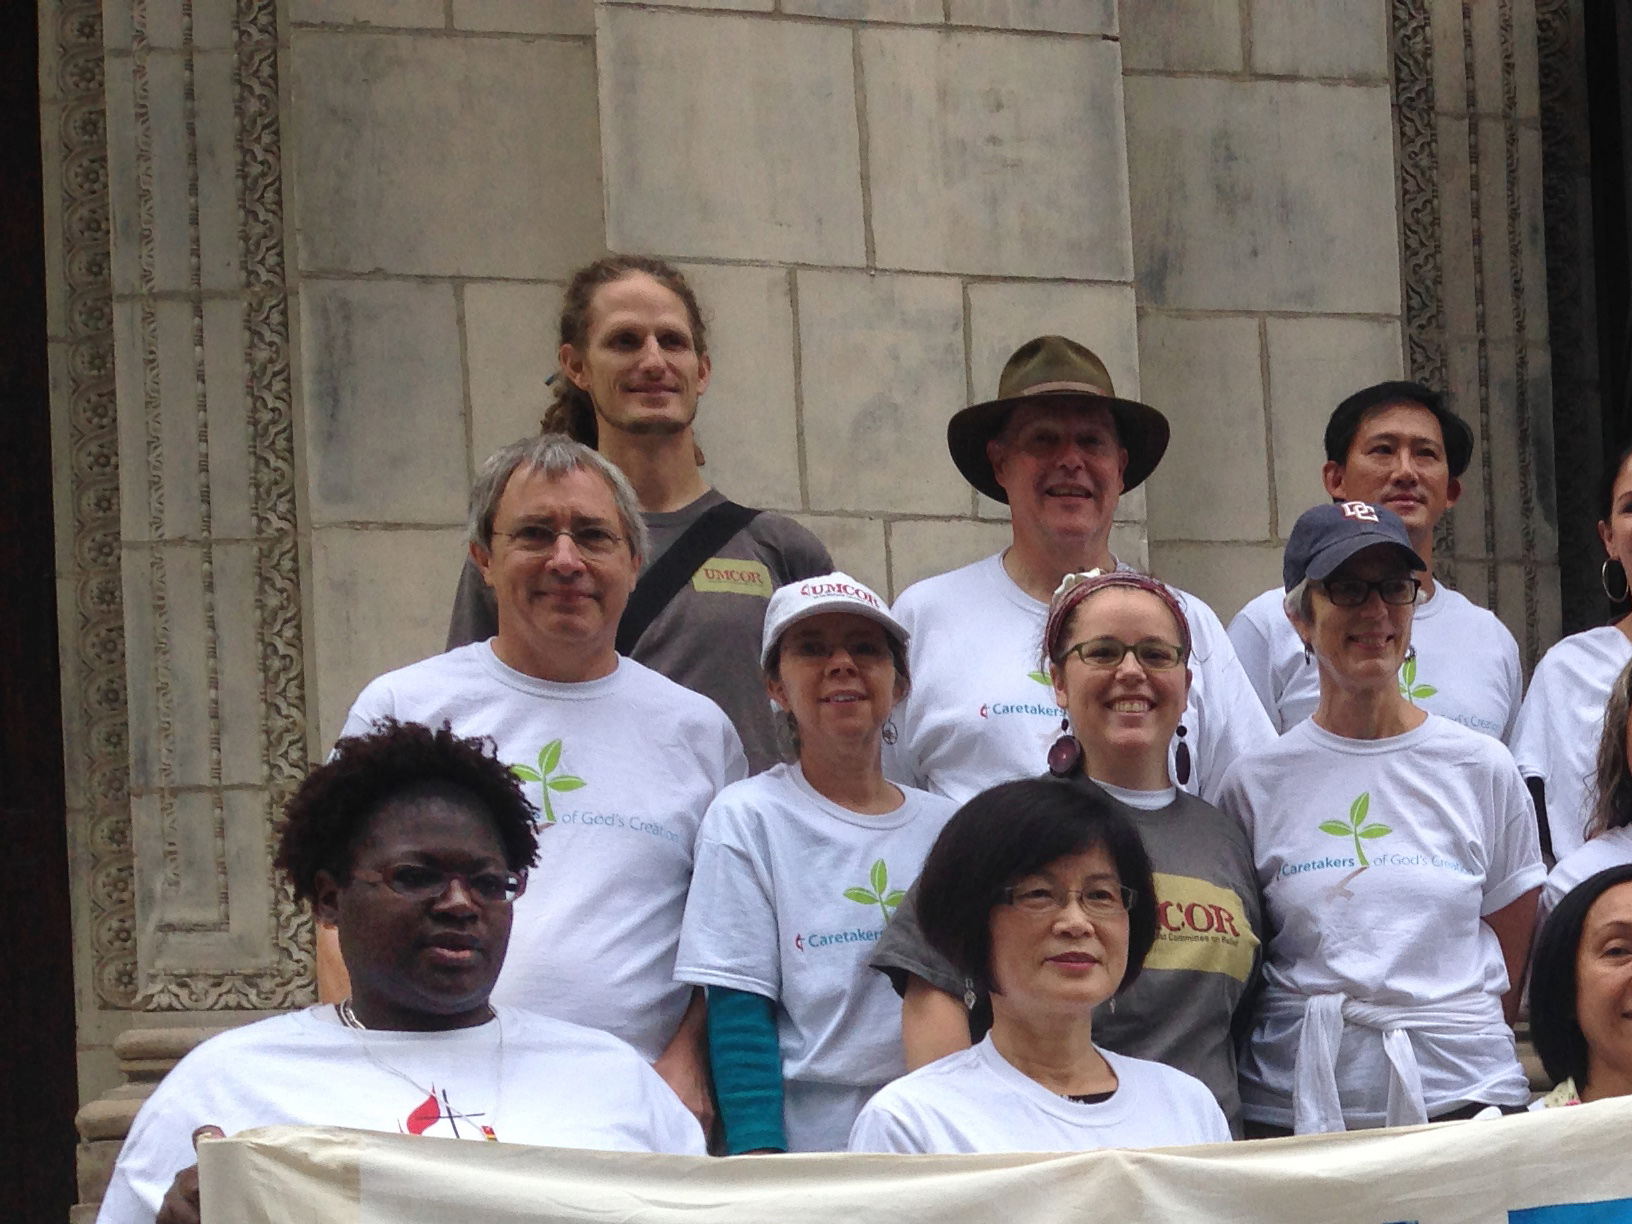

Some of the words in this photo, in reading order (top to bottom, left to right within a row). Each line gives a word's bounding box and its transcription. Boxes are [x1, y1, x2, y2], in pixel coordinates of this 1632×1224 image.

[704, 568, 763, 584] UMCOR
[811, 583, 880, 608] UMCOR
[562, 811, 578, 824] of
[582, 811, 625, 828] God's
[1281, 857, 1355, 877] Caretakers
[1374, 854, 1387, 866] of
[1391, 854, 1427, 866] God's
[1157, 900, 1241, 937] COR
